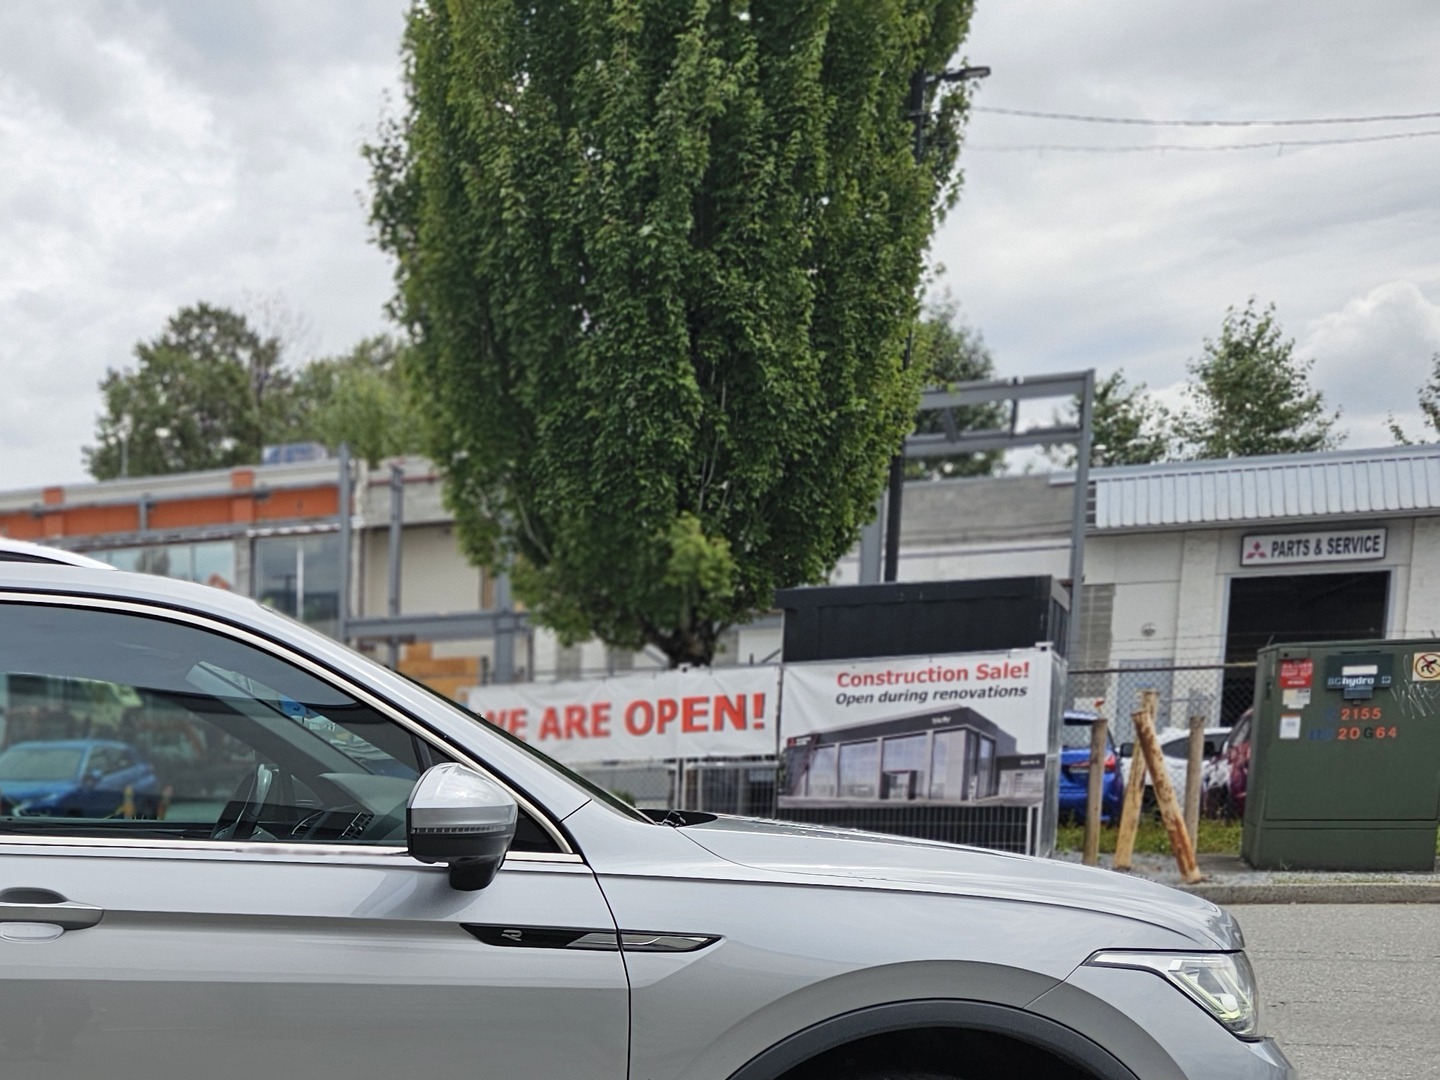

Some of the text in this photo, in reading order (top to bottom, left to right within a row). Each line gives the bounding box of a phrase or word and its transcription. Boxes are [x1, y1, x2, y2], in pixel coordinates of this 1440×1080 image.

[1271, 534, 1381, 558] PARTS & SERVICE
[836, 661, 1031, 688] Construction Sale!
[835, 685, 1028, 706] Open during renovations
[538, 703, 612, 741] ARE
[623, 692, 767, 736] OPEN!
[1341, 707, 1382, 721] 2155
